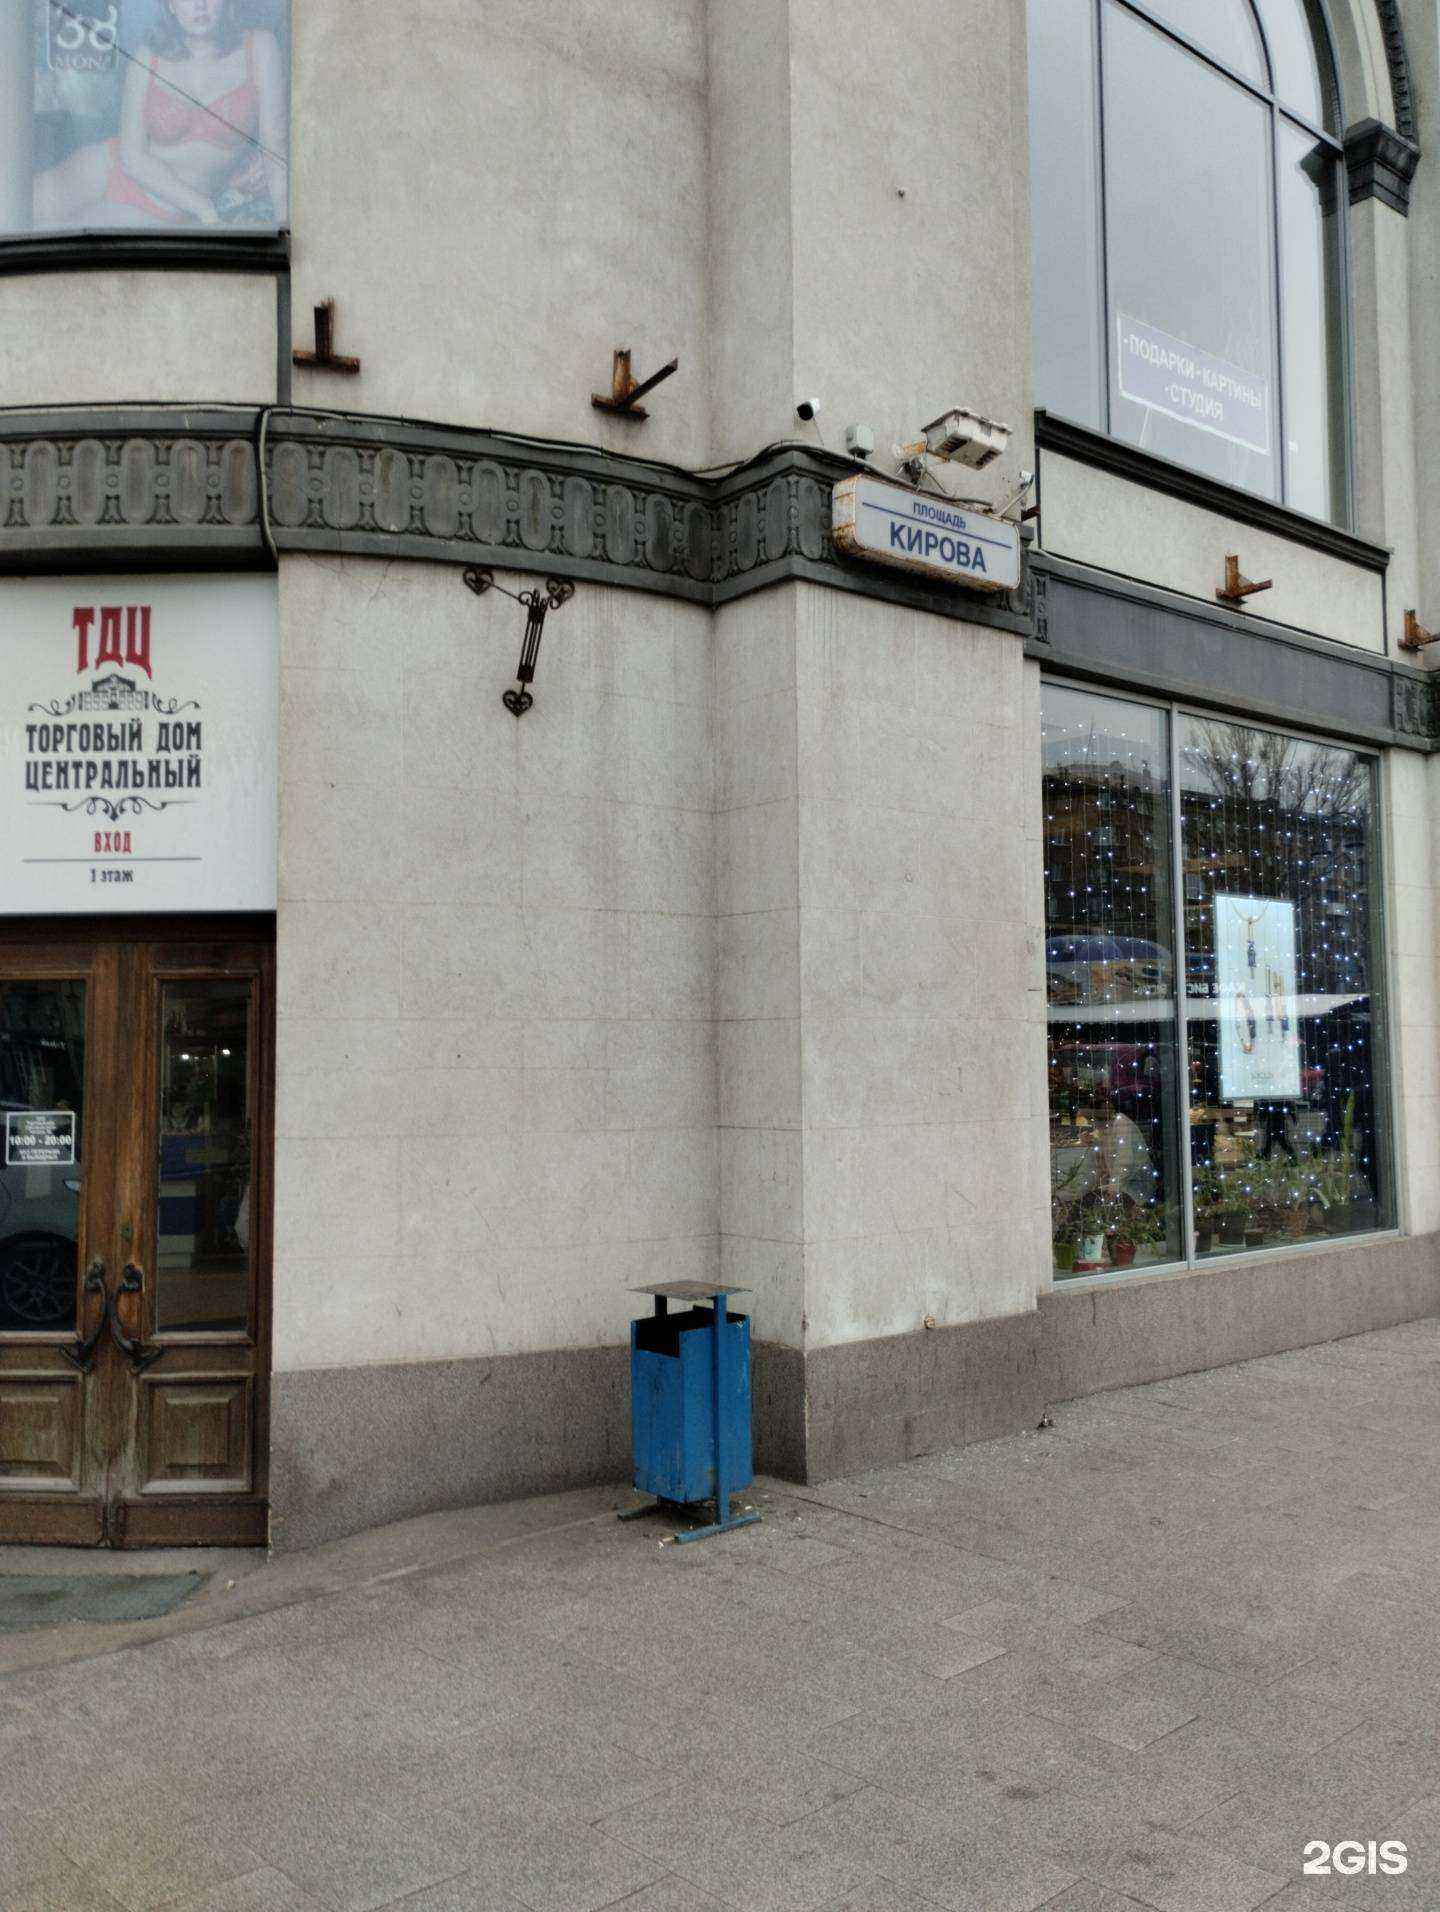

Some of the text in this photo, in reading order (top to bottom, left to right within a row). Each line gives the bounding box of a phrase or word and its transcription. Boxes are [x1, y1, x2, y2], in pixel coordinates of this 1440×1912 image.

[1129, 333, 1262, 409] ПОДАРКИ КАРТИНЫ
[1170, 384, 1224, 421] СТУДИЯ
[913, 502, 967, 529] ПЛОЩАДЬ
[890, 521, 987, 572] КИРОВА
[73, 606, 152, 681] ТДЦ
[26, 718, 202, 753] ТОРГОВЫЙ ДОМ
[25, 755, 201, 791] ЦЕНТРАЛЬНЫЙ
[94, 831, 132, 853] ВХОД
[91, 869, 133, 883] 1 этаж
[9, 1135, 36, 1146] 10:00
[45, 1135, 72, 1146] 20:00
